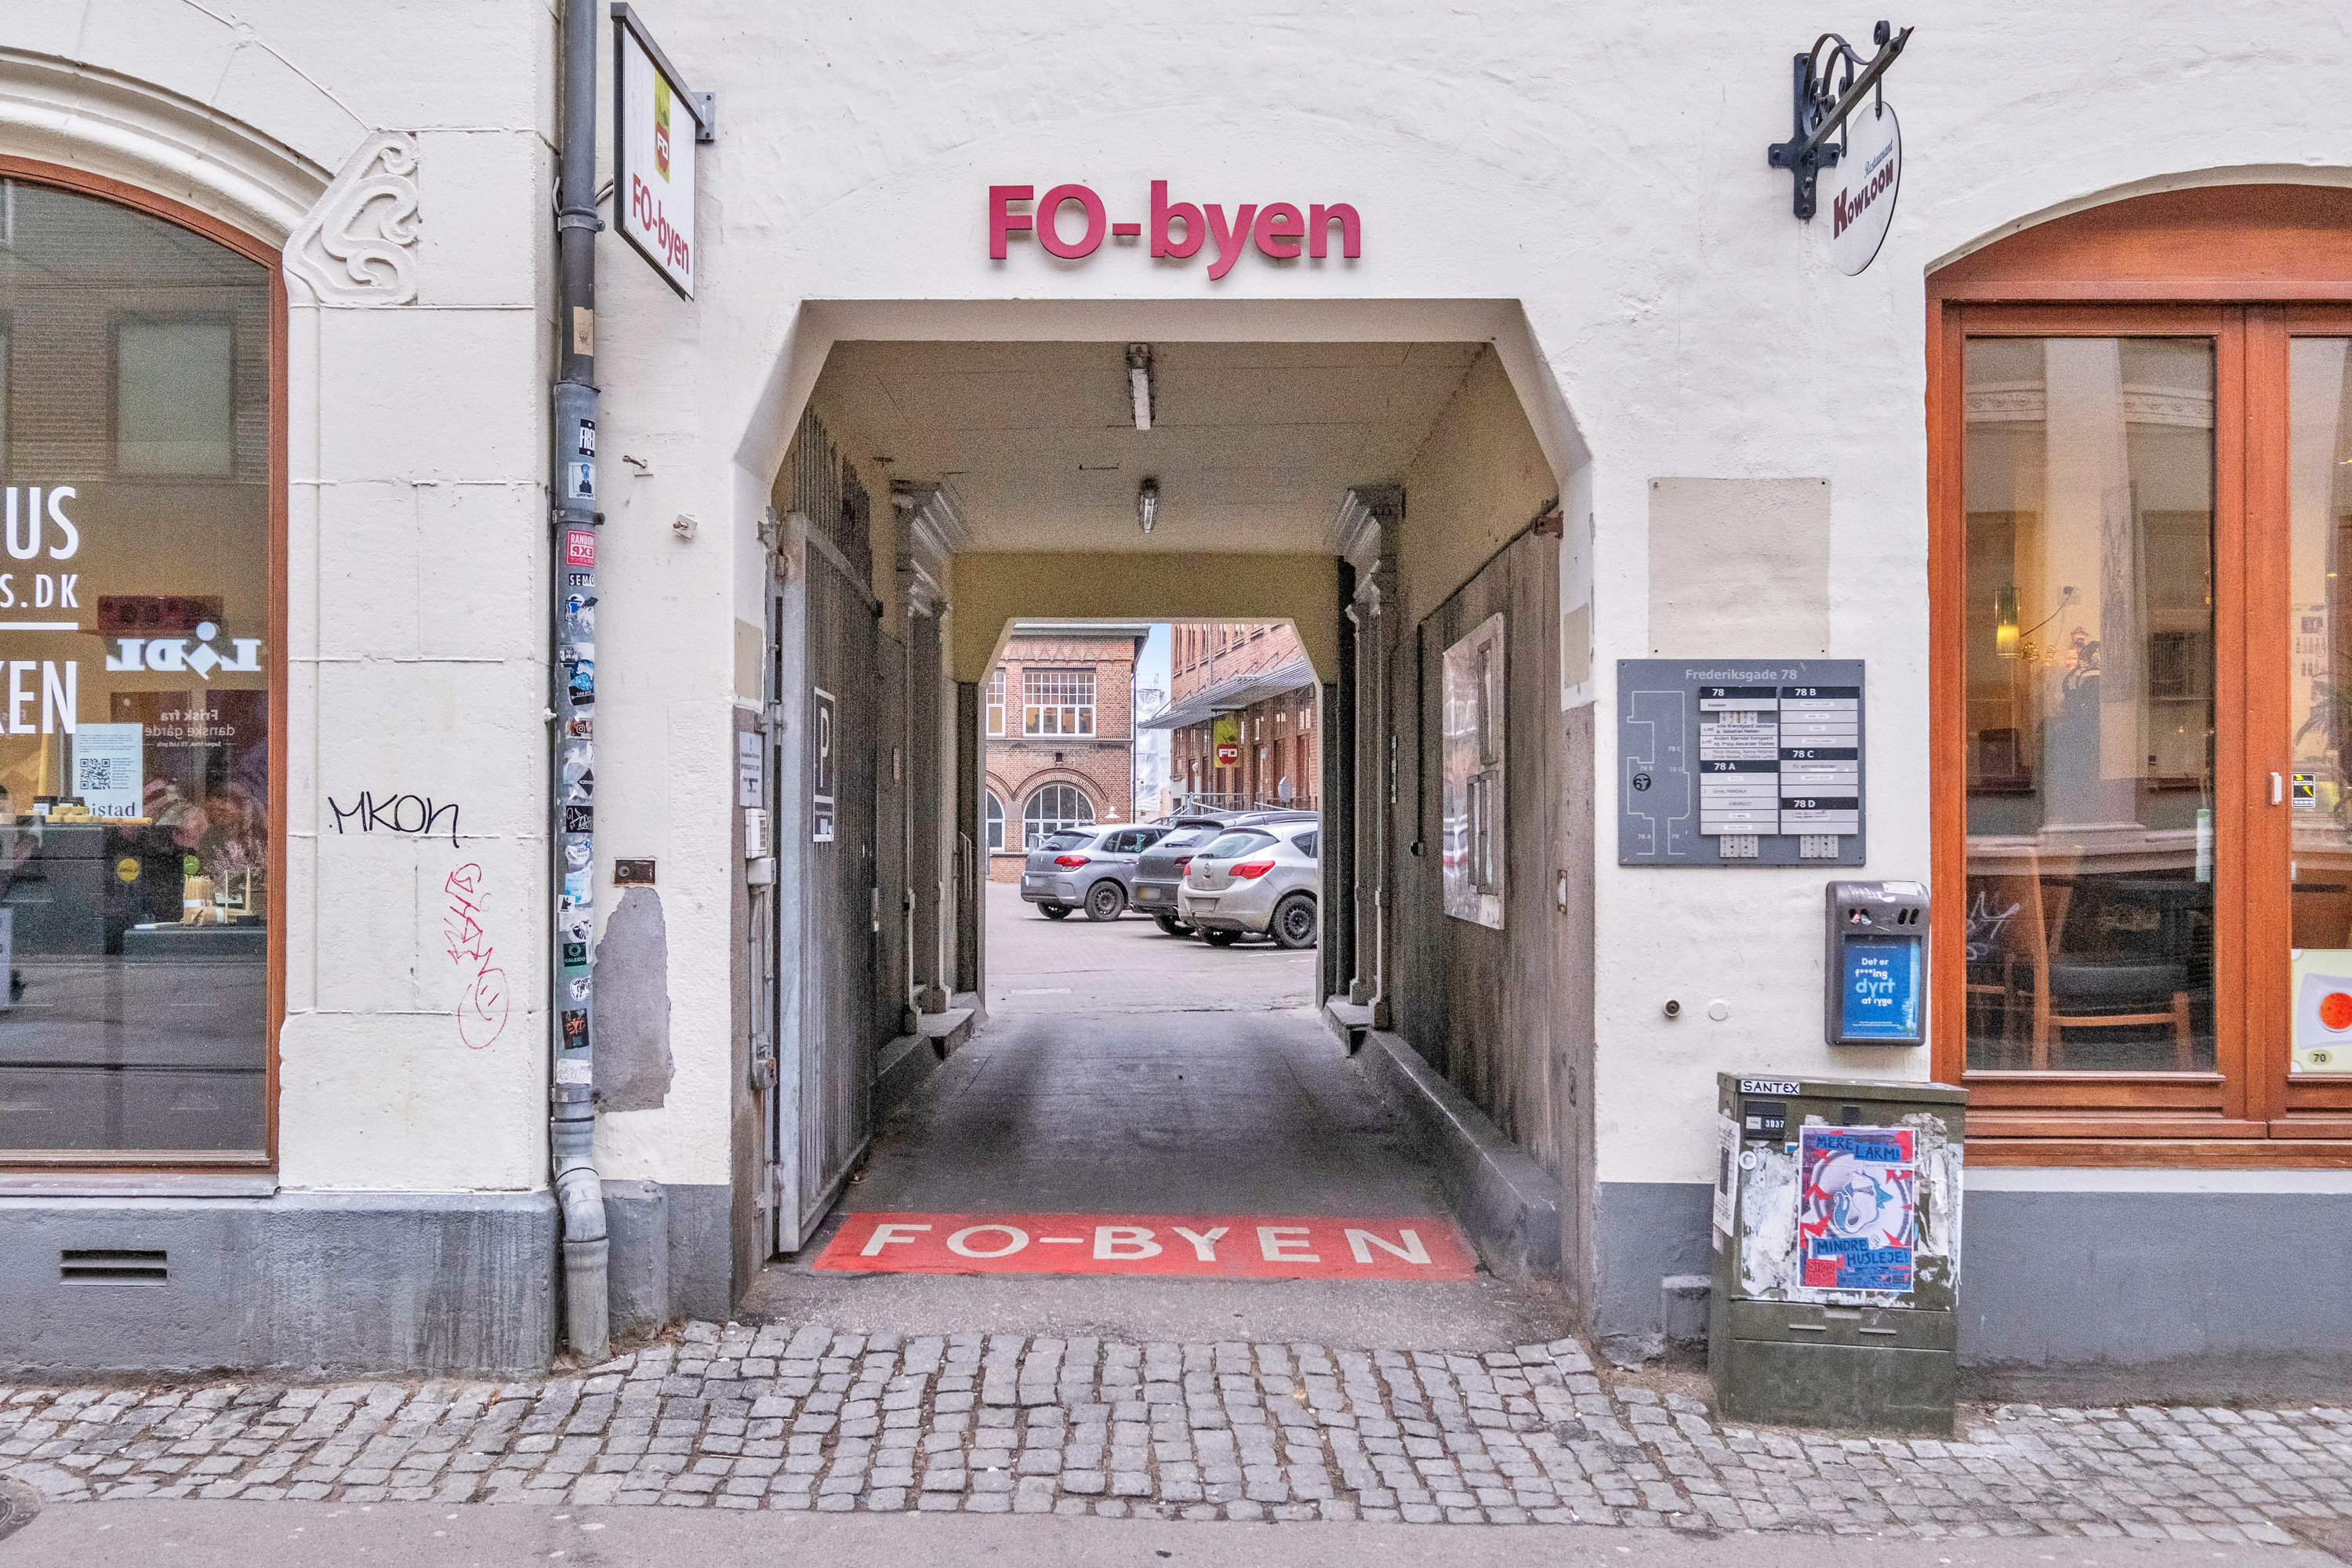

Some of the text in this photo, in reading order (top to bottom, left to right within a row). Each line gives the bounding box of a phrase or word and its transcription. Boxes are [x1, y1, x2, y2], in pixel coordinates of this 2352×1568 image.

[657, 131, 669, 162] FO
[633, 172, 689, 274] FO-byen
[989, 180, 1361, 281] FO-byen
[1686, 669, 1797, 682] Frederiksgade 78
[0, 661, 77, 735] EN
[1219, 749, 1237, 757] FO
[89, 802, 136, 816] istad
[1856, 978, 1896, 998] dyrt
[1874, 998, 1893, 1007] ryge
[1743, 1081, 1799, 1094] SANTEX
[1817, 1136, 1853, 1149] MERE
[1856, 1145, 1900, 1160] LARM!
[860, 1223, 1432, 1264] FO-BYEN
[1817, 1240, 1868, 1253] MINDRE
[1847, 1252, 1907, 1266] HUSLEJE!
